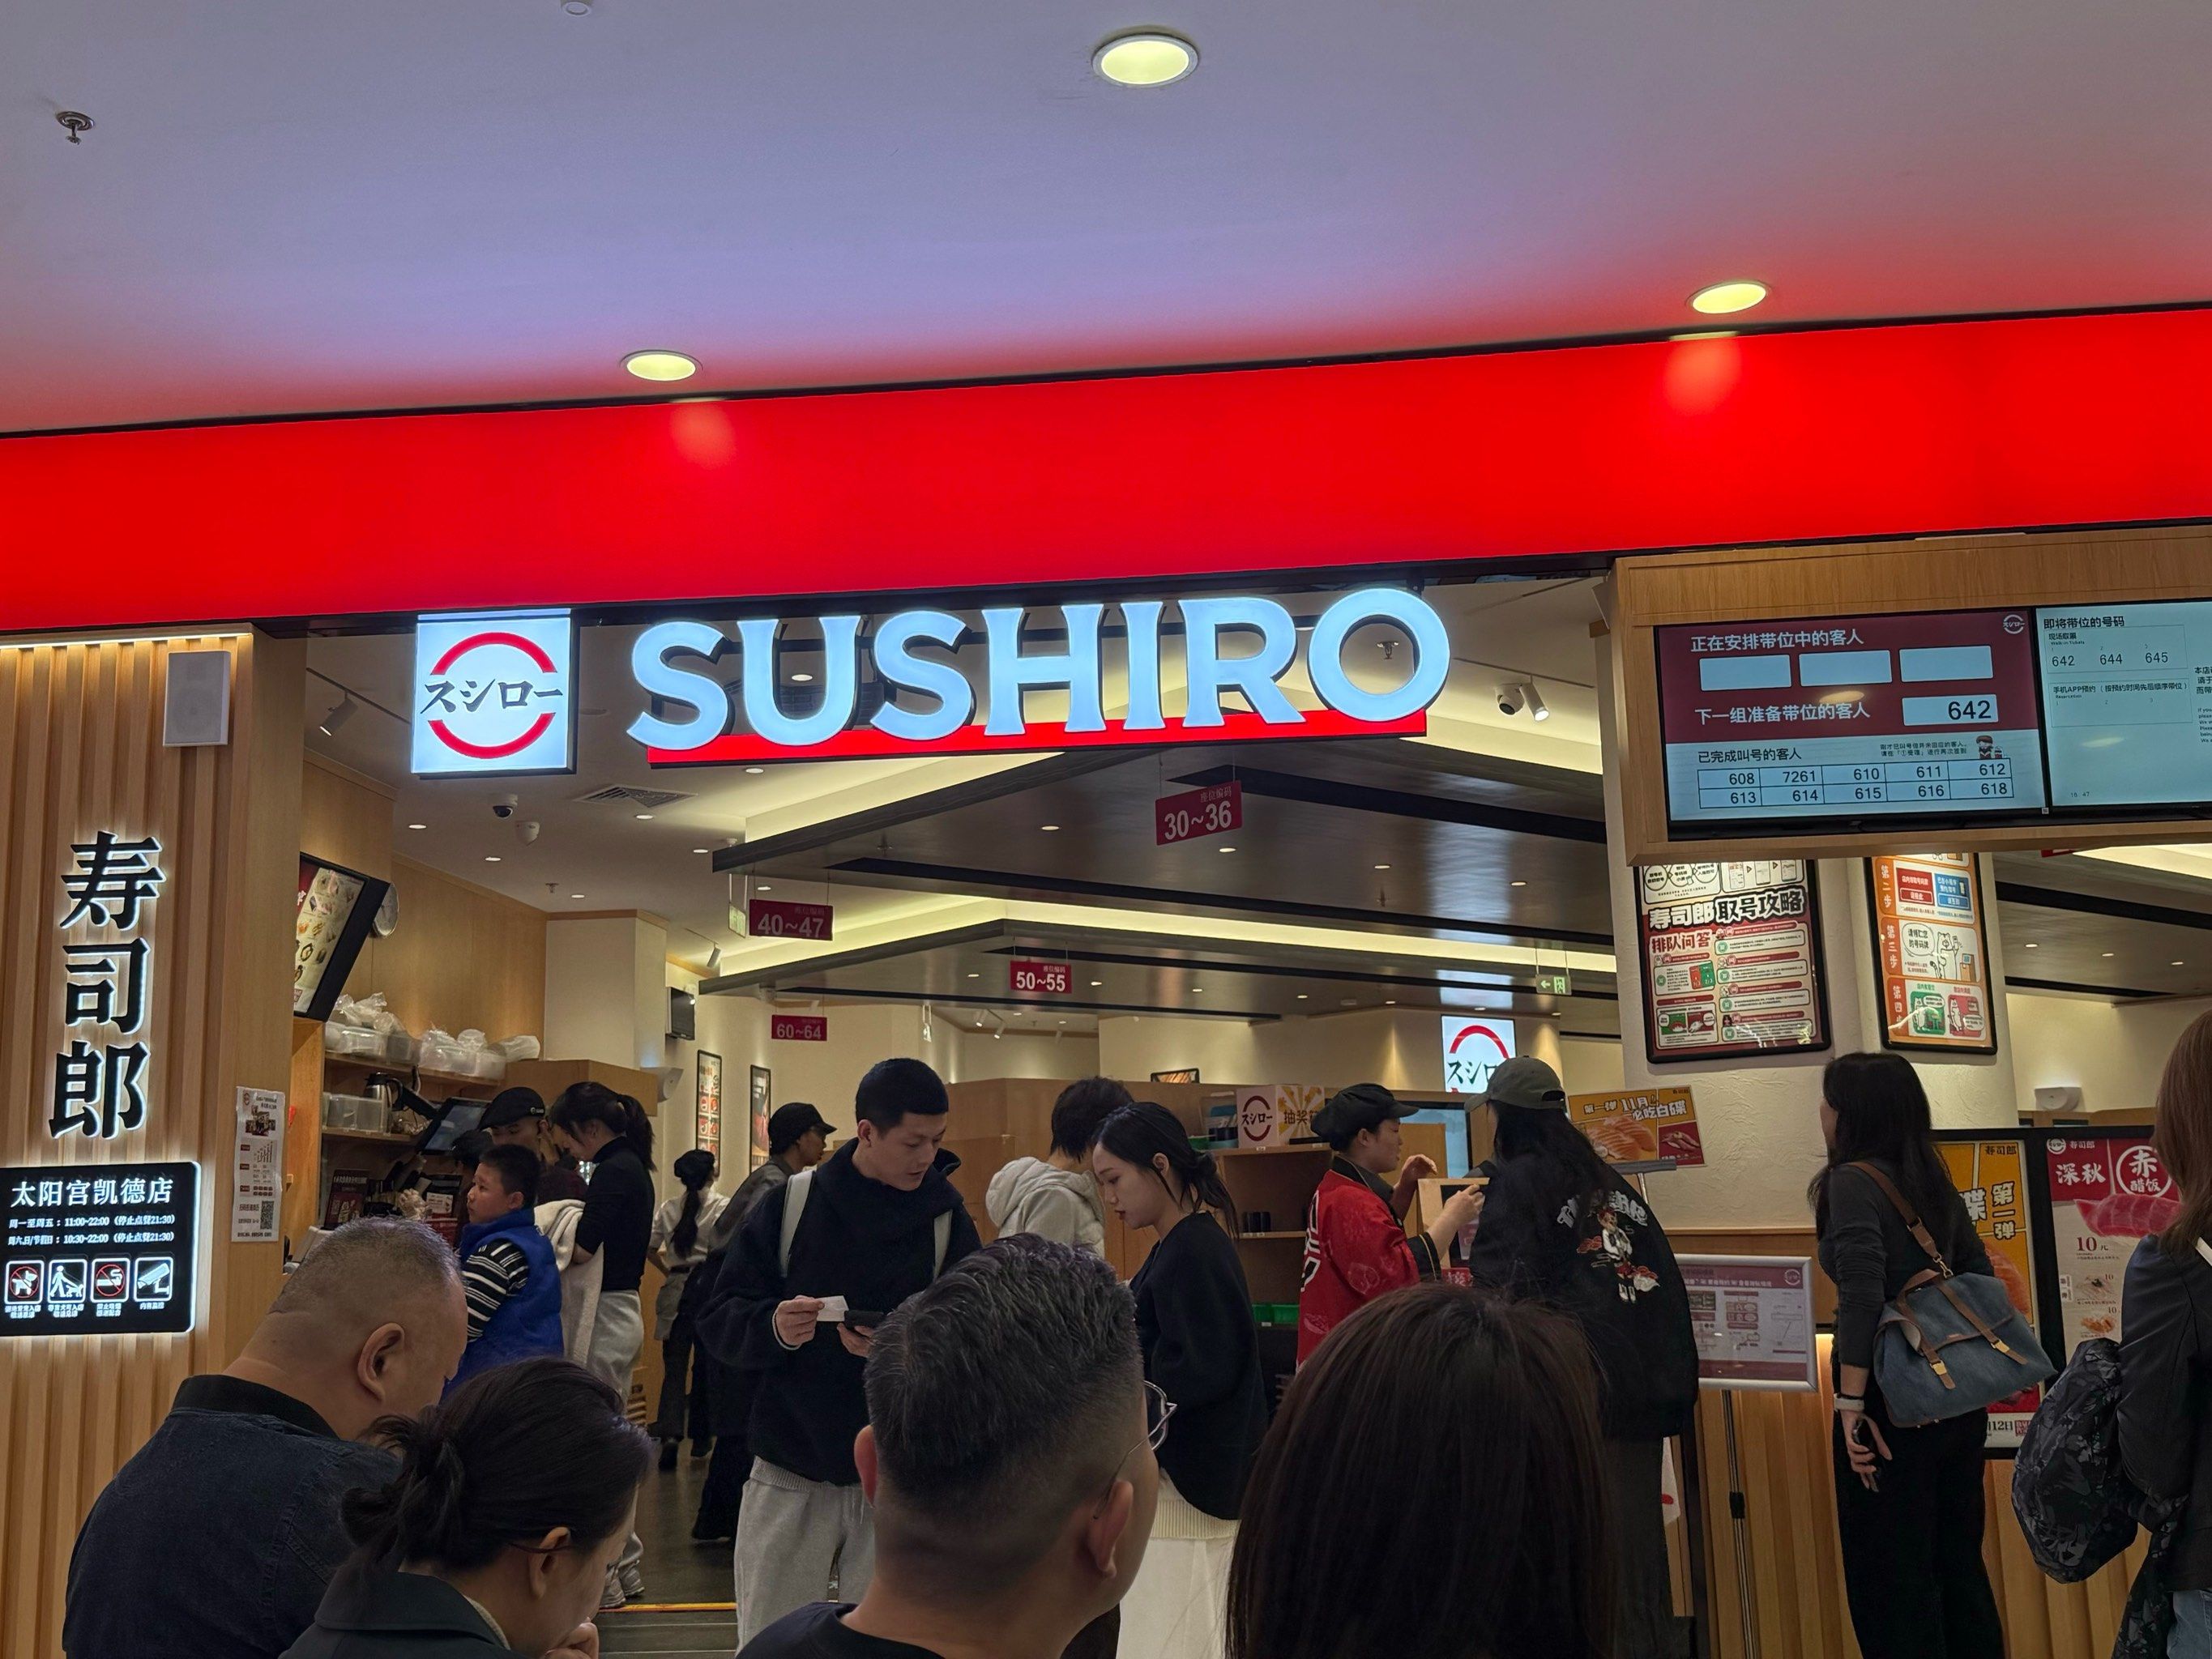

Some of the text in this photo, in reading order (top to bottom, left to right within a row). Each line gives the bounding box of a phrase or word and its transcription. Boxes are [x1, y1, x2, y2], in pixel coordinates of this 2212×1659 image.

[2043, 616, 2124, 629] 即将带位的号码
[1690, 629, 1864, 653] 正在安排带位中的客人
[626, 587, 1450, 750] SUSHIRO
[2052, 655, 2075, 667] 642
[2099, 653, 2123, 665] 644
[2145, 651, 2168, 663] 645
[421, 677, 563, 714] スシロー
[1694, 702, 1871, 726] 下一组准备带位的客人
[1947, 700, 1992, 720] 642
[1697, 747, 1802, 764] 已完成叫号的客人
[1729, 763, 2005, 786] 608 7261 610 611 612
[1730, 782, 2008, 805] 613 614 615 616 618
[1164, 800, 1232, 840] 30~36
[1881, 864, 1892, 908] 第二步
[1649, 890, 1804, 931] 寿司郎取号攻略
[758, 913, 824, 938] 40~47
[1651, 932, 1711, 954] 排队问答
[1886, 924, 1898, 969] 第三步
[49, 830, 167, 1139] 寿司郎
[1016, 971, 1065, 992] 50~55
[776, 1022, 822, 1039] 60~64
[1241, 1113, 1273, 1126] スシロー
[1633, 1099, 1687, 1121] 必吃白碟
[1985, 1145, 2017, 1156] 寿司郎
[2056, 1162, 2106, 1186] 深秋
[2129, 1149, 2158, 1177] 赤
[11, 1177, 173, 1208] 太阳宫凯德店
[2129, 1178, 2161, 1193] 醋饭
[1992, 1181, 2015, 1240] 第一弹
[2077, 1236, 2097, 1252] 10
